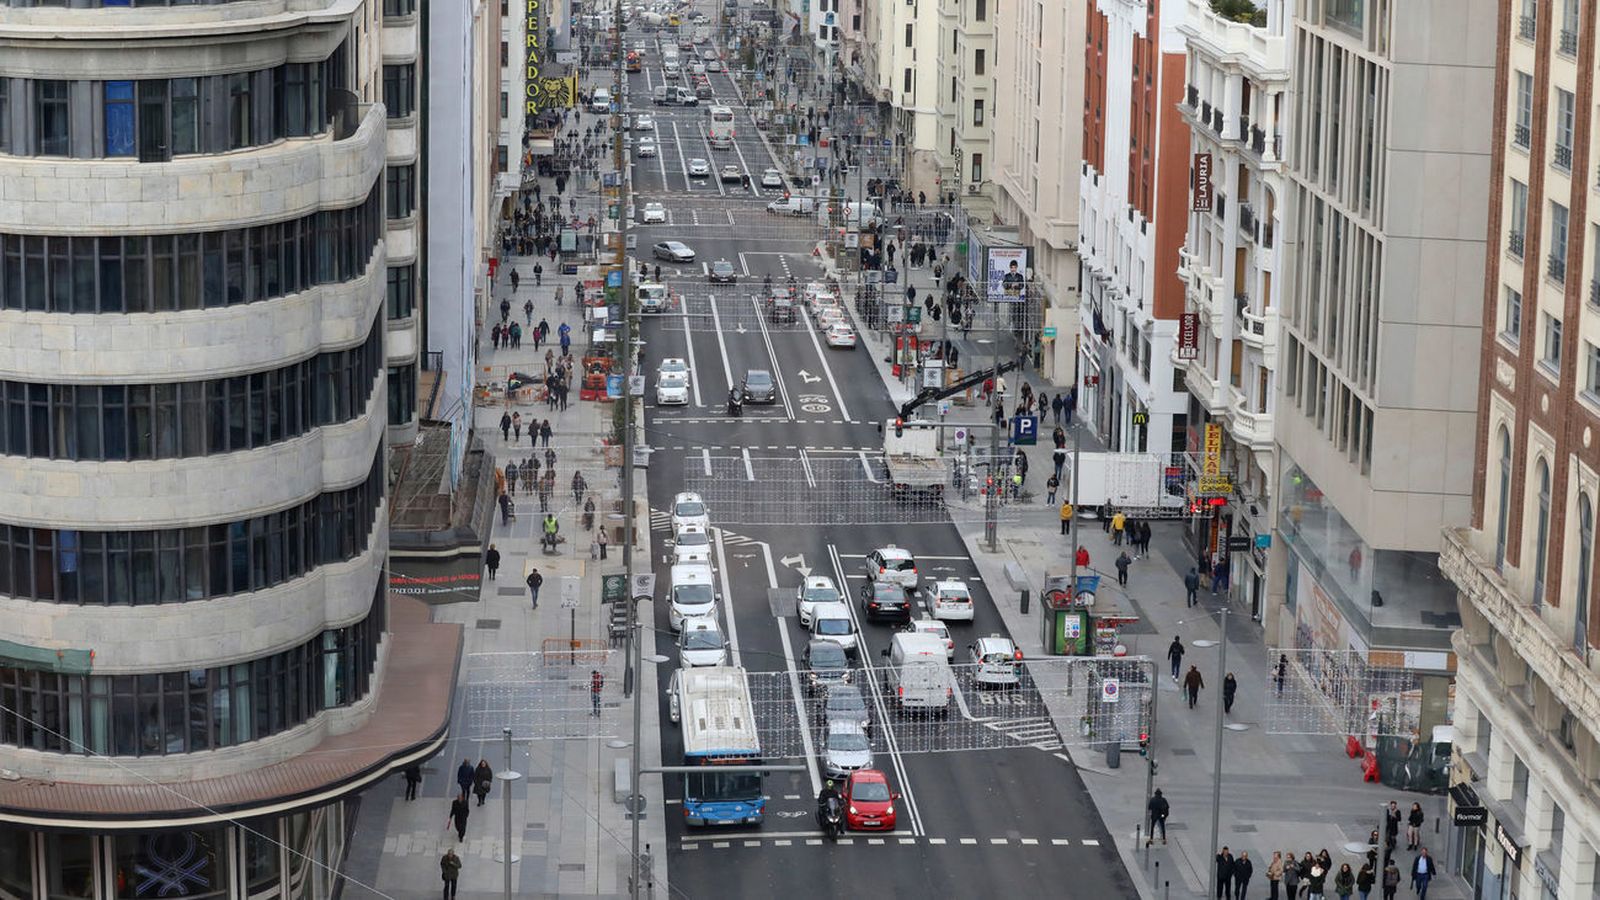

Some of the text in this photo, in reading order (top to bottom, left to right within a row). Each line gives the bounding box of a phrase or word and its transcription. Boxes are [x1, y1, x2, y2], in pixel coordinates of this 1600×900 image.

[527, 0, 539, 115] PERADOR
[1199, 155, 1208, 198] LAURIA
[1184, 314, 1194, 348] EXCELSIOR
[1020, 419, 1032, 434] P
[979, 693, 1027, 706] BUS
